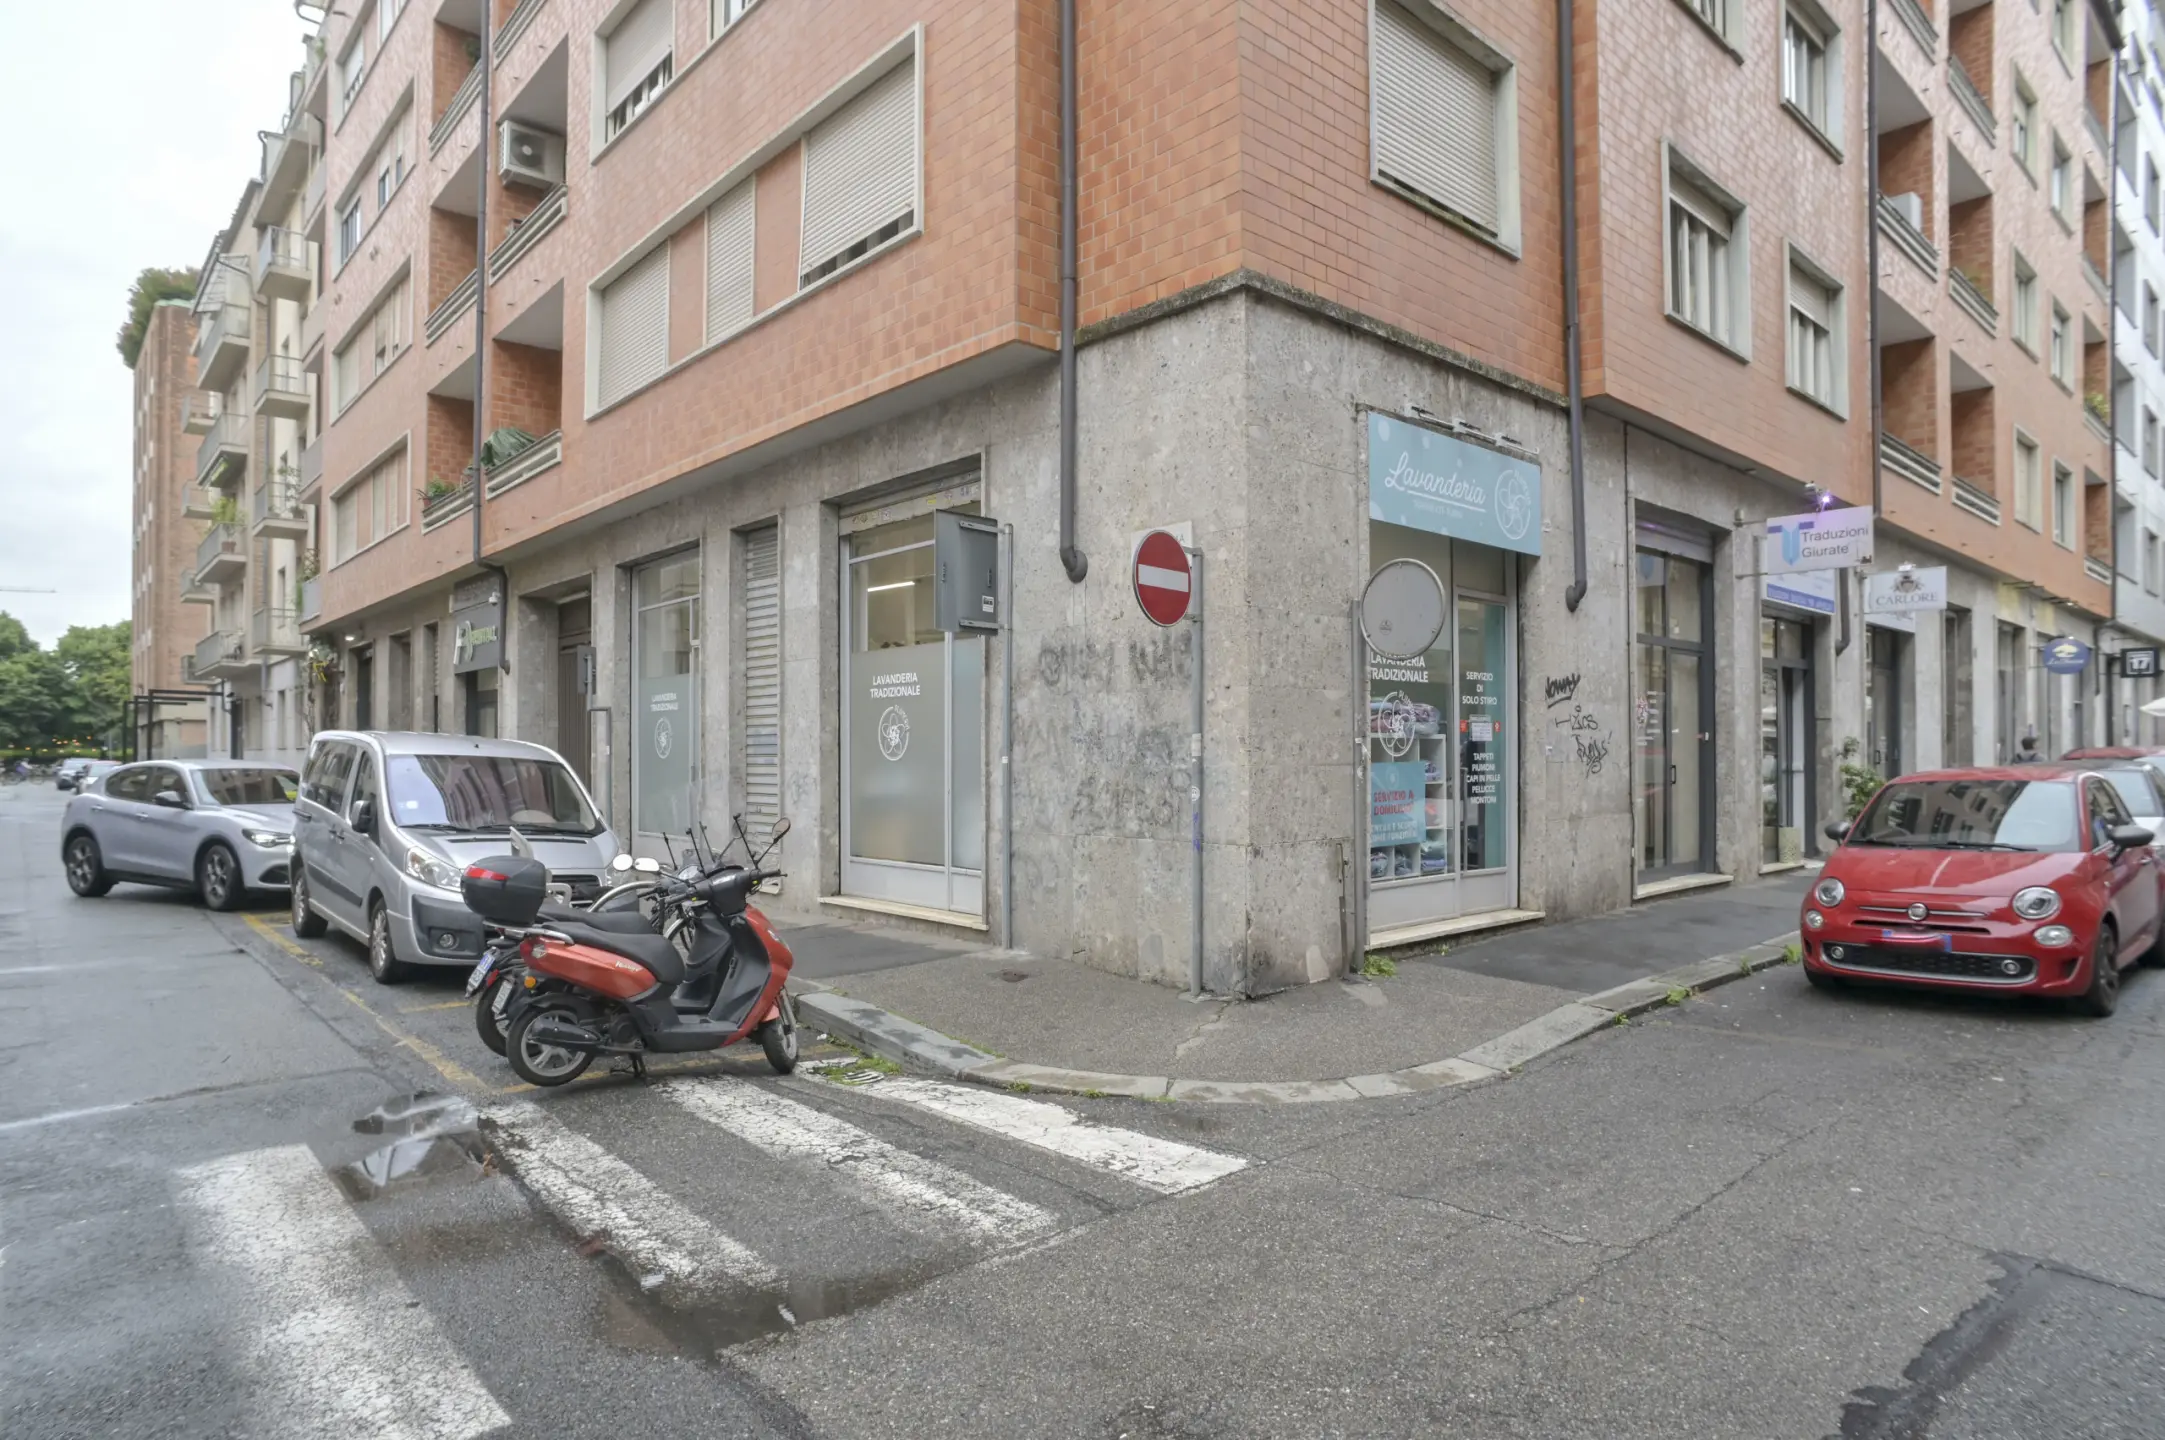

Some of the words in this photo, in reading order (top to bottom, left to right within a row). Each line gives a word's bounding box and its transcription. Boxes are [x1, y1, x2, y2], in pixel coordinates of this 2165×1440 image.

[1384, 451, 1486, 505] Lavanderia
[1801, 526, 1869, 543] Traduzioni
[1801, 543, 1849, 558] Giurate
[1875, 591, 1938, 606] CARLORE
[872, 672, 918, 686] LAVANDERIA
[1466, 671, 1493, 681] SERVIZIO
[869, 685, 921, 698] TRADIZIONALE
[1476, 684, 1484, 693] DI
[1462, 696, 1479, 705] SOLO
[1480, 696, 1498, 705] STIRO
[1473, 752, 1494, 761] TAPPETI
[1471, 763, 1495, 772] PIUMONI
[1466, 774, 1478, 783] CAPI
[1479, 774, 1485, 782] IN
[1486, 774, 1500, 782] PELLE
[1374, 790, 1406, 802] SERVIZIO
[1470, 796, 1497, 804] MONTONI
